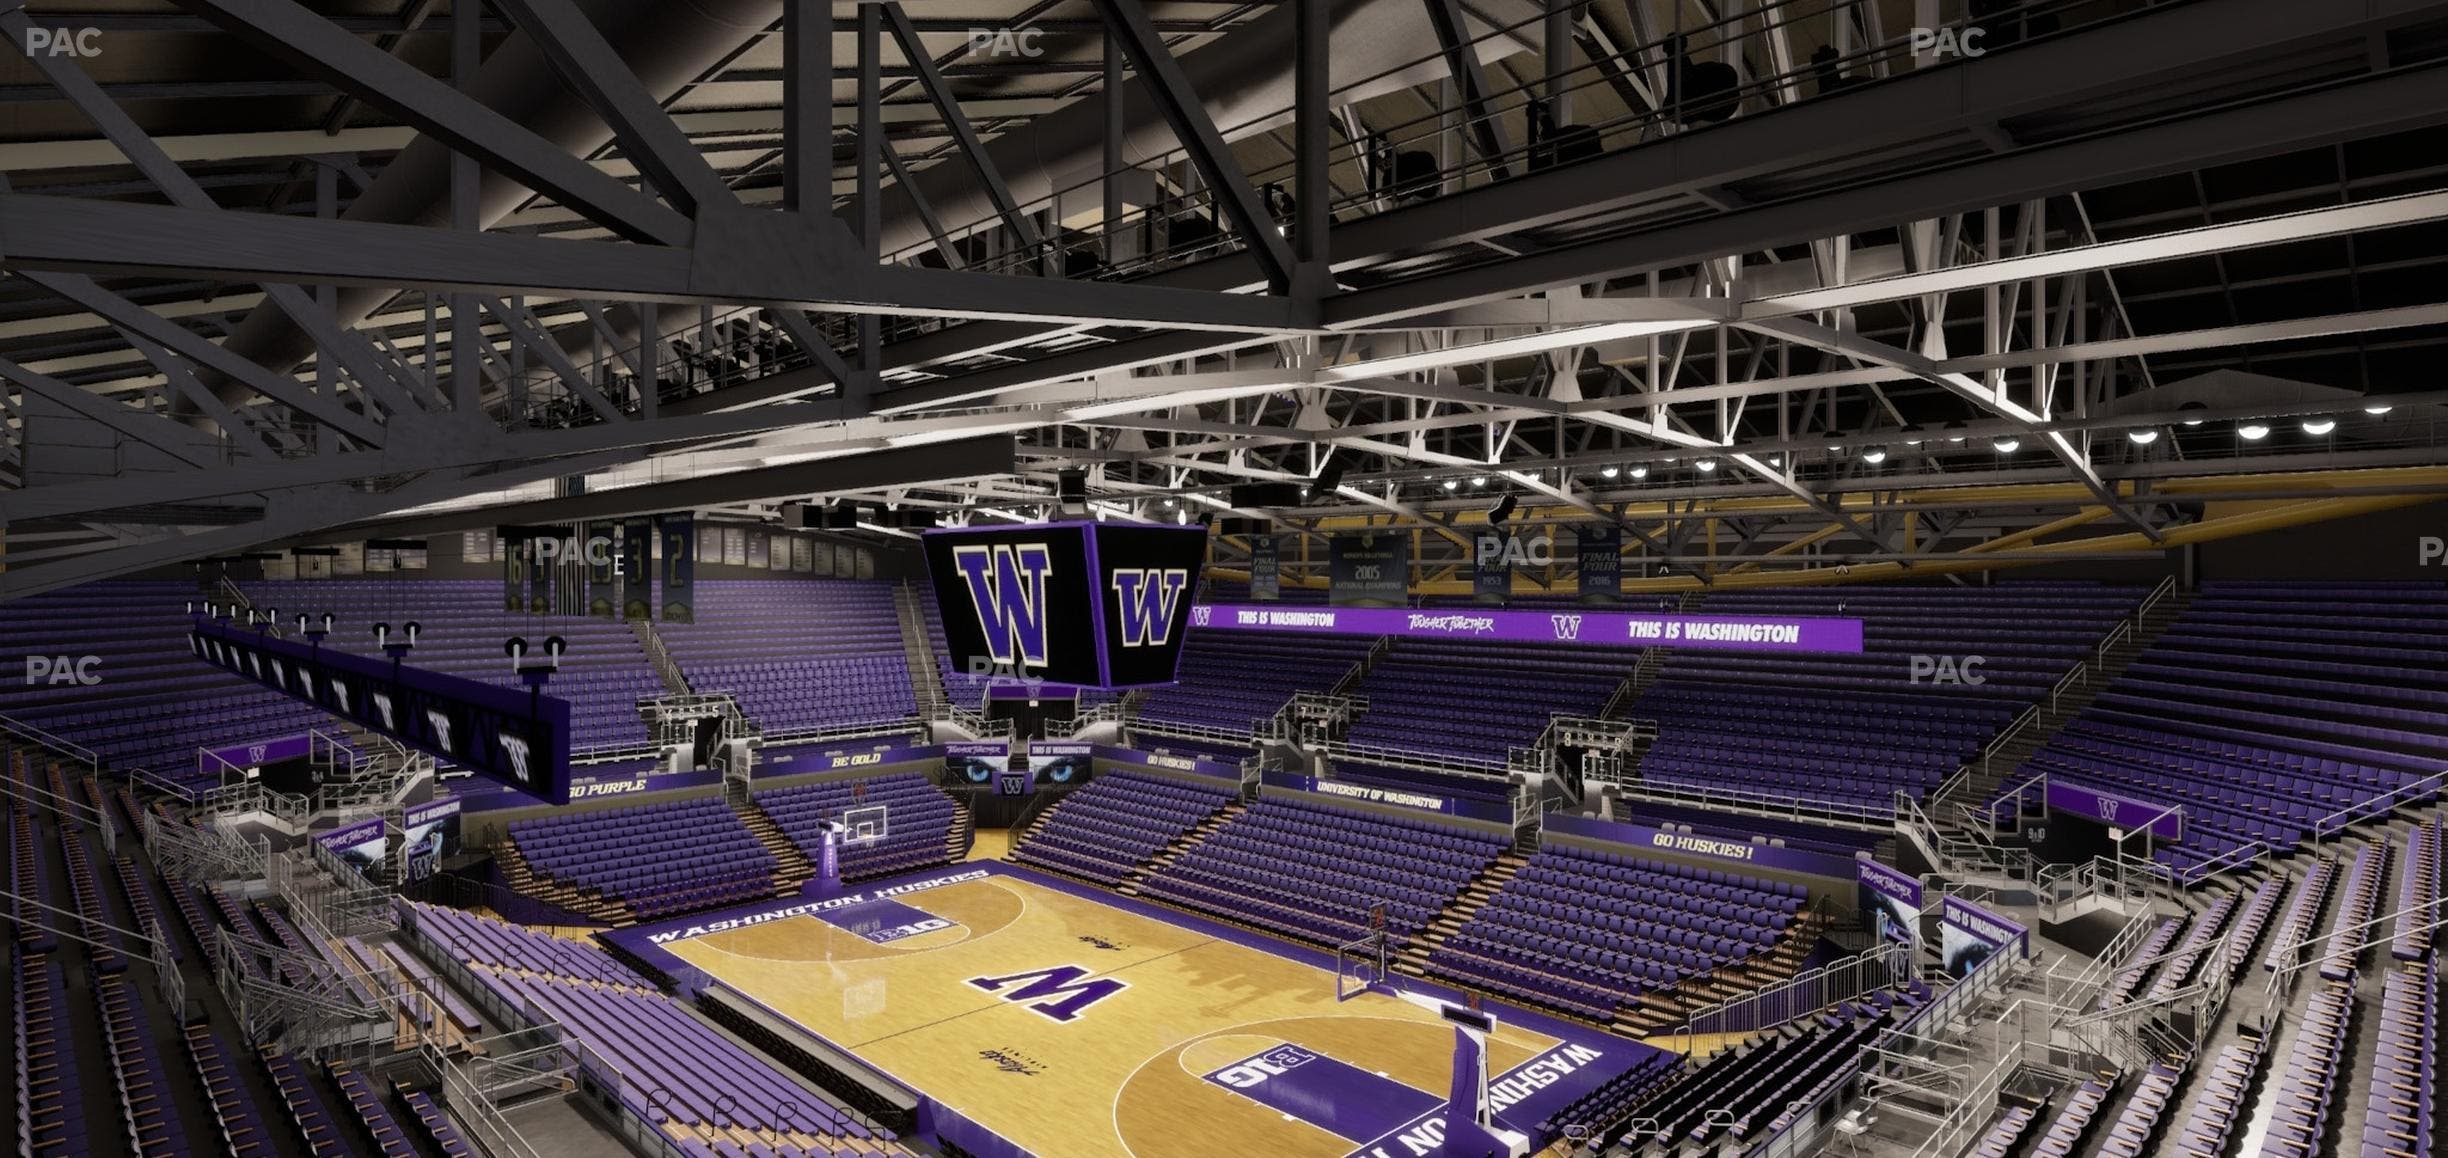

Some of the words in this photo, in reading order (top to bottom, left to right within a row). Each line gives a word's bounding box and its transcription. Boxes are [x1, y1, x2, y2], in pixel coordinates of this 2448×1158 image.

[1355, 565, 1380, 580] 2005
[953, 543, 1053, 667] W
[1112, 568, 1187, 647] W
[1238, 611, 1257, 625] THIS
[1259, 611, 1268, 625] IS
[1270, 611, 1334, 627] WASHINGTON
[1551, 615, 1581, 640] W
[1628, 620, 1662, 639] THIS
[1664, 621, 1681, 640] IS
[1684, 622, 1800, 643] WASHINGTON
[832, 757, 849, 768] BE
[851, 753, 882, 765] GOLD
[587, 779, 647, 796] PURPLE
[1317, 781, 1370, 798] UNIVERSITY
[1370, 789, 1383, 800] OF
[1384, 791, 1442, 809] WASHINGTON
[1653, 833, 1674, 847] GO
[646, 894, 863, 945] WASHINGTON
[874, 869, 990, 899] HUSKIES
[1946, 904, 1961, 922] THIS
[1961, 911, 1969, 926] IS
